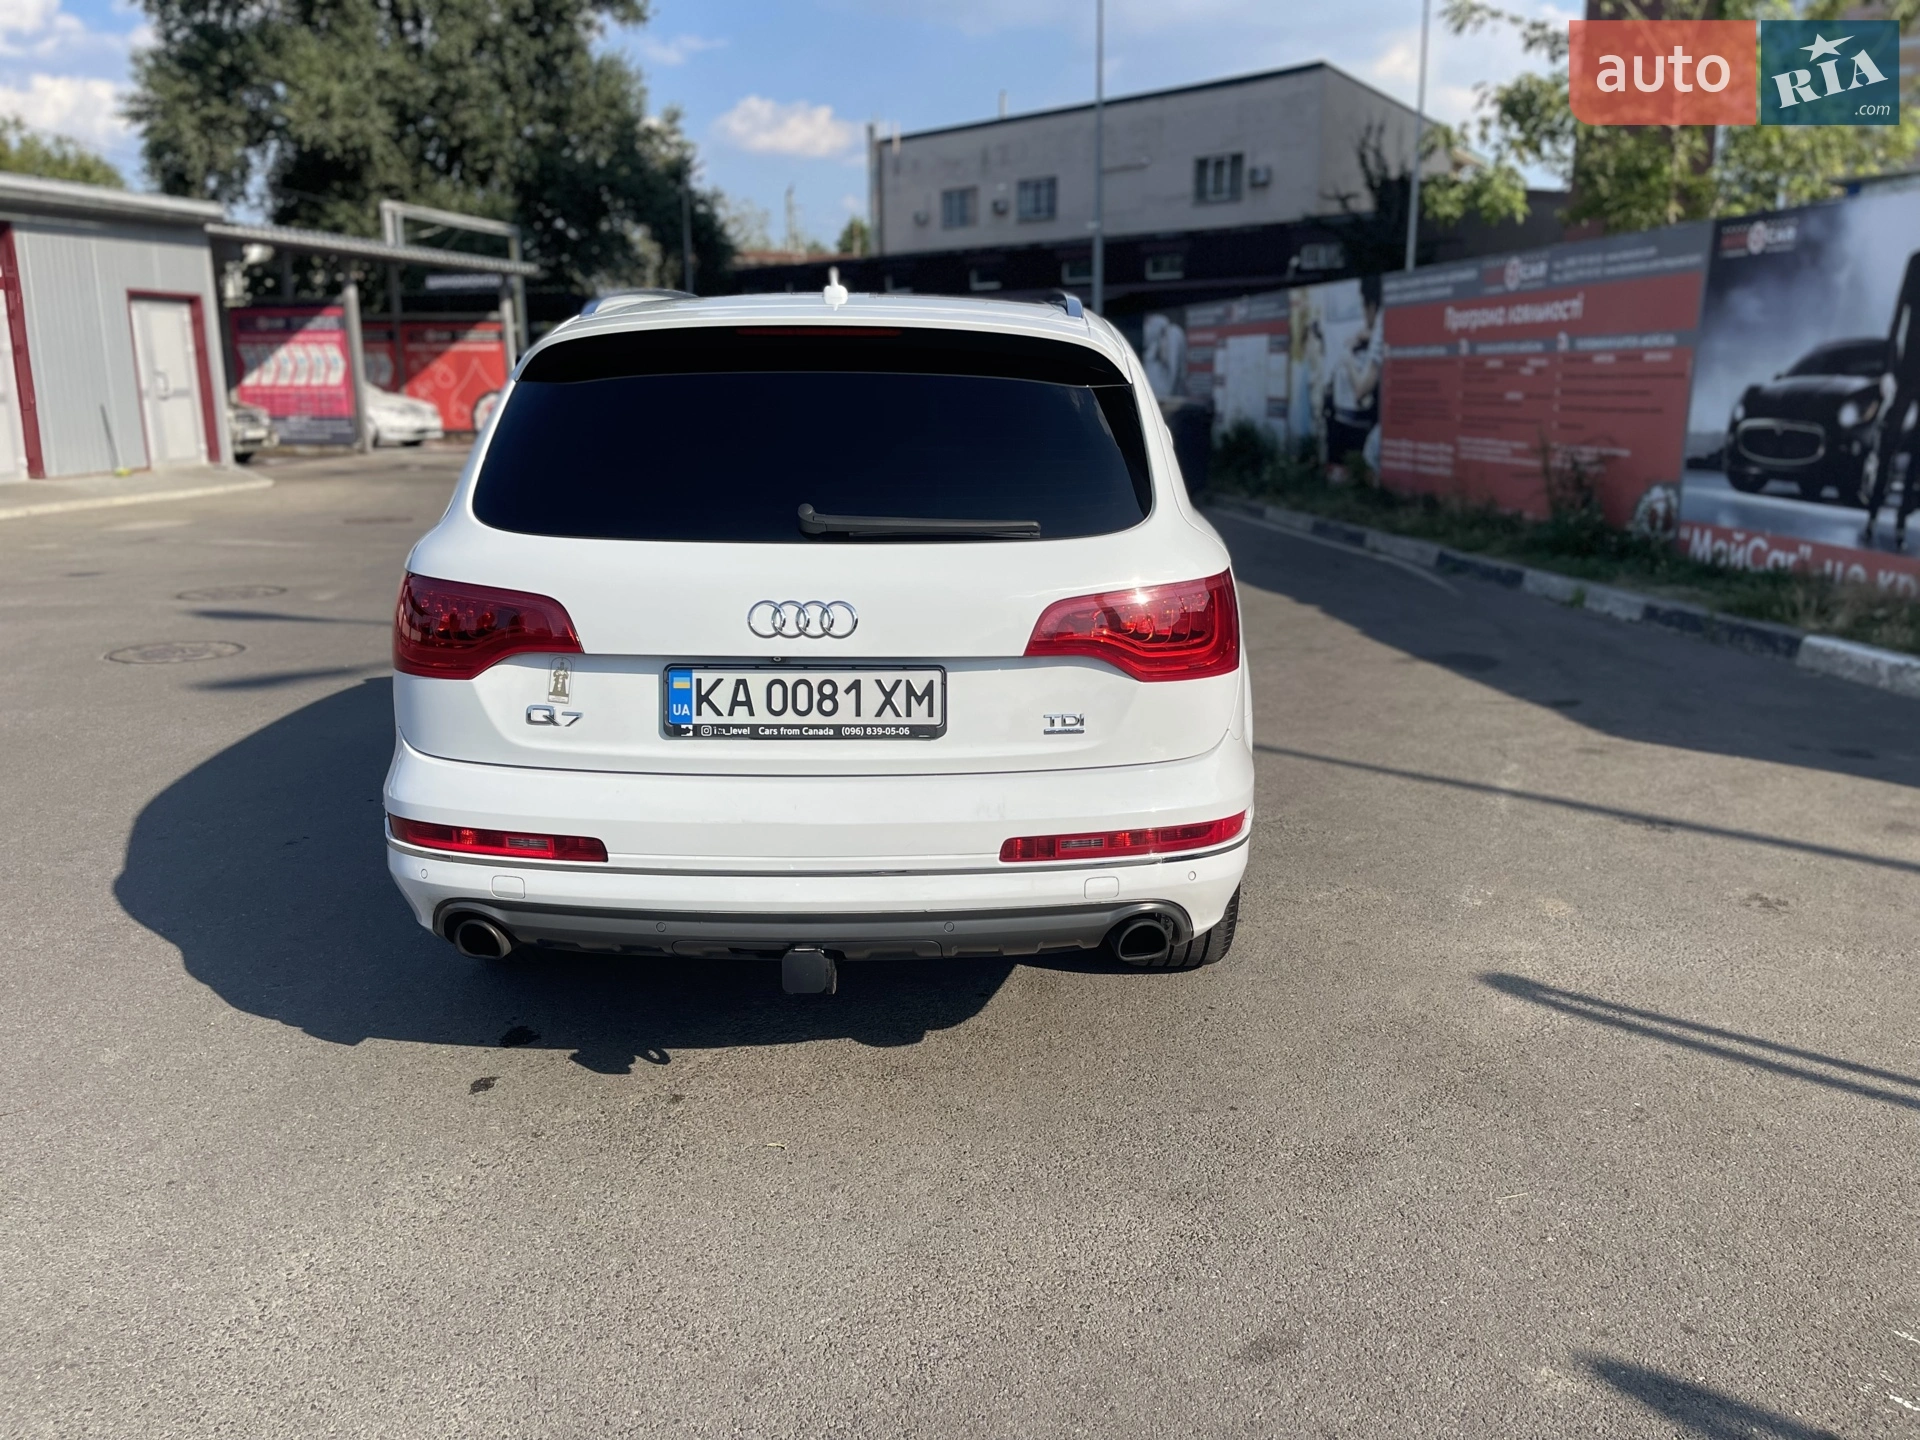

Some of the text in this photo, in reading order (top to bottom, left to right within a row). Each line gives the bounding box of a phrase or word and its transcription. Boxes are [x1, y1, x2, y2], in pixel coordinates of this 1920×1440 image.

[695, 678, 934, 718] KA 0081 XM
[525, 704, 584, 727] Q7
[673, 705, 690, 716] UA
[758, 726, 778, 735] Cars
[780, 726, 800, 735] from
[802, 726, 834, 735] Canada
[841, 726, 864, 736] (096)
[866, 726, 910, 735] 839-05-06
